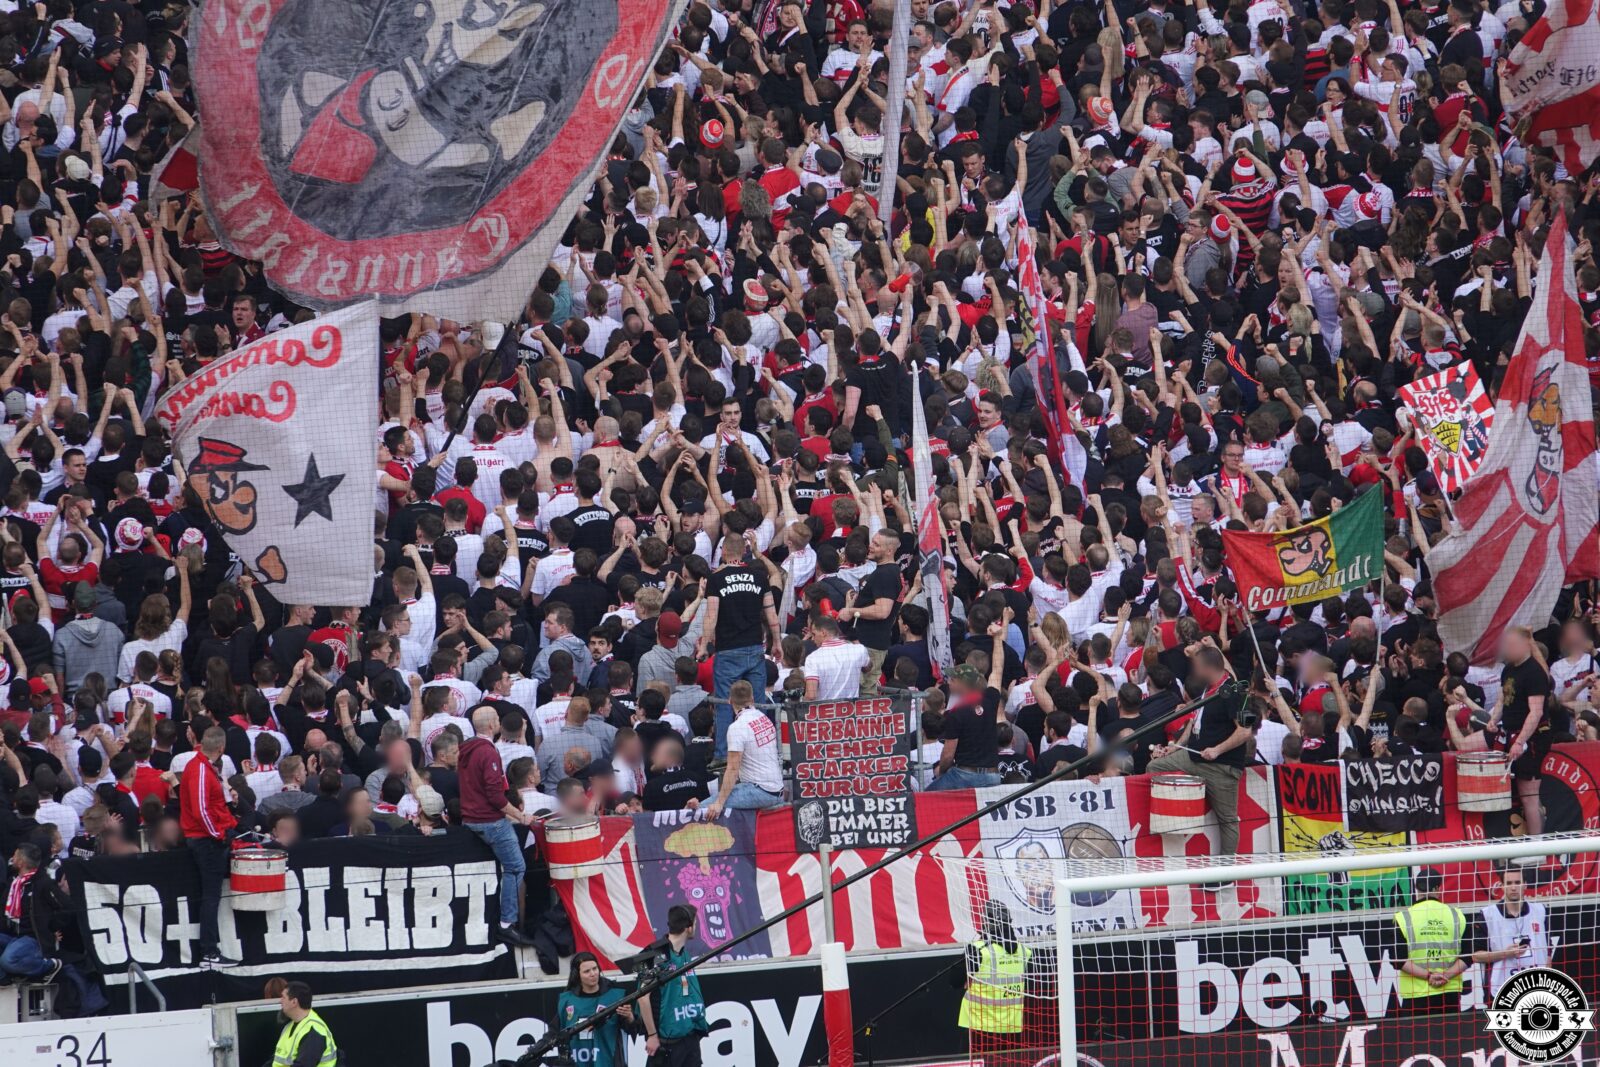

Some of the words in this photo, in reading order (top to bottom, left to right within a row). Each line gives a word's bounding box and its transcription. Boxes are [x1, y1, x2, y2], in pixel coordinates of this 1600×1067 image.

[724, 573, 754, 584] SENZA
[719, 583, 762, 598] PADRONI
[805, 698, 893, 721] JEDER
[792, 713, 906, 743] VERBANNTE
[806, 736, 897, 760] KEHRT
[1346, 758, 1441, 793] CHECCO
[826, 799, 855, 814] DU
[864, 797, 907, 813] BIST
[985, 795, 1056, 822] WSB
[828, 812, 910, 832] IMMER
[1465, 823, 1484, 840] 19
[830, 830, 859, 847] BEI
[867, 829, 912, 845] UNS!
[264, 860, 497, 954] BLEIBT
[426, 993, 823, 1067] beay
[56, 1031, 112, 1067] 34
